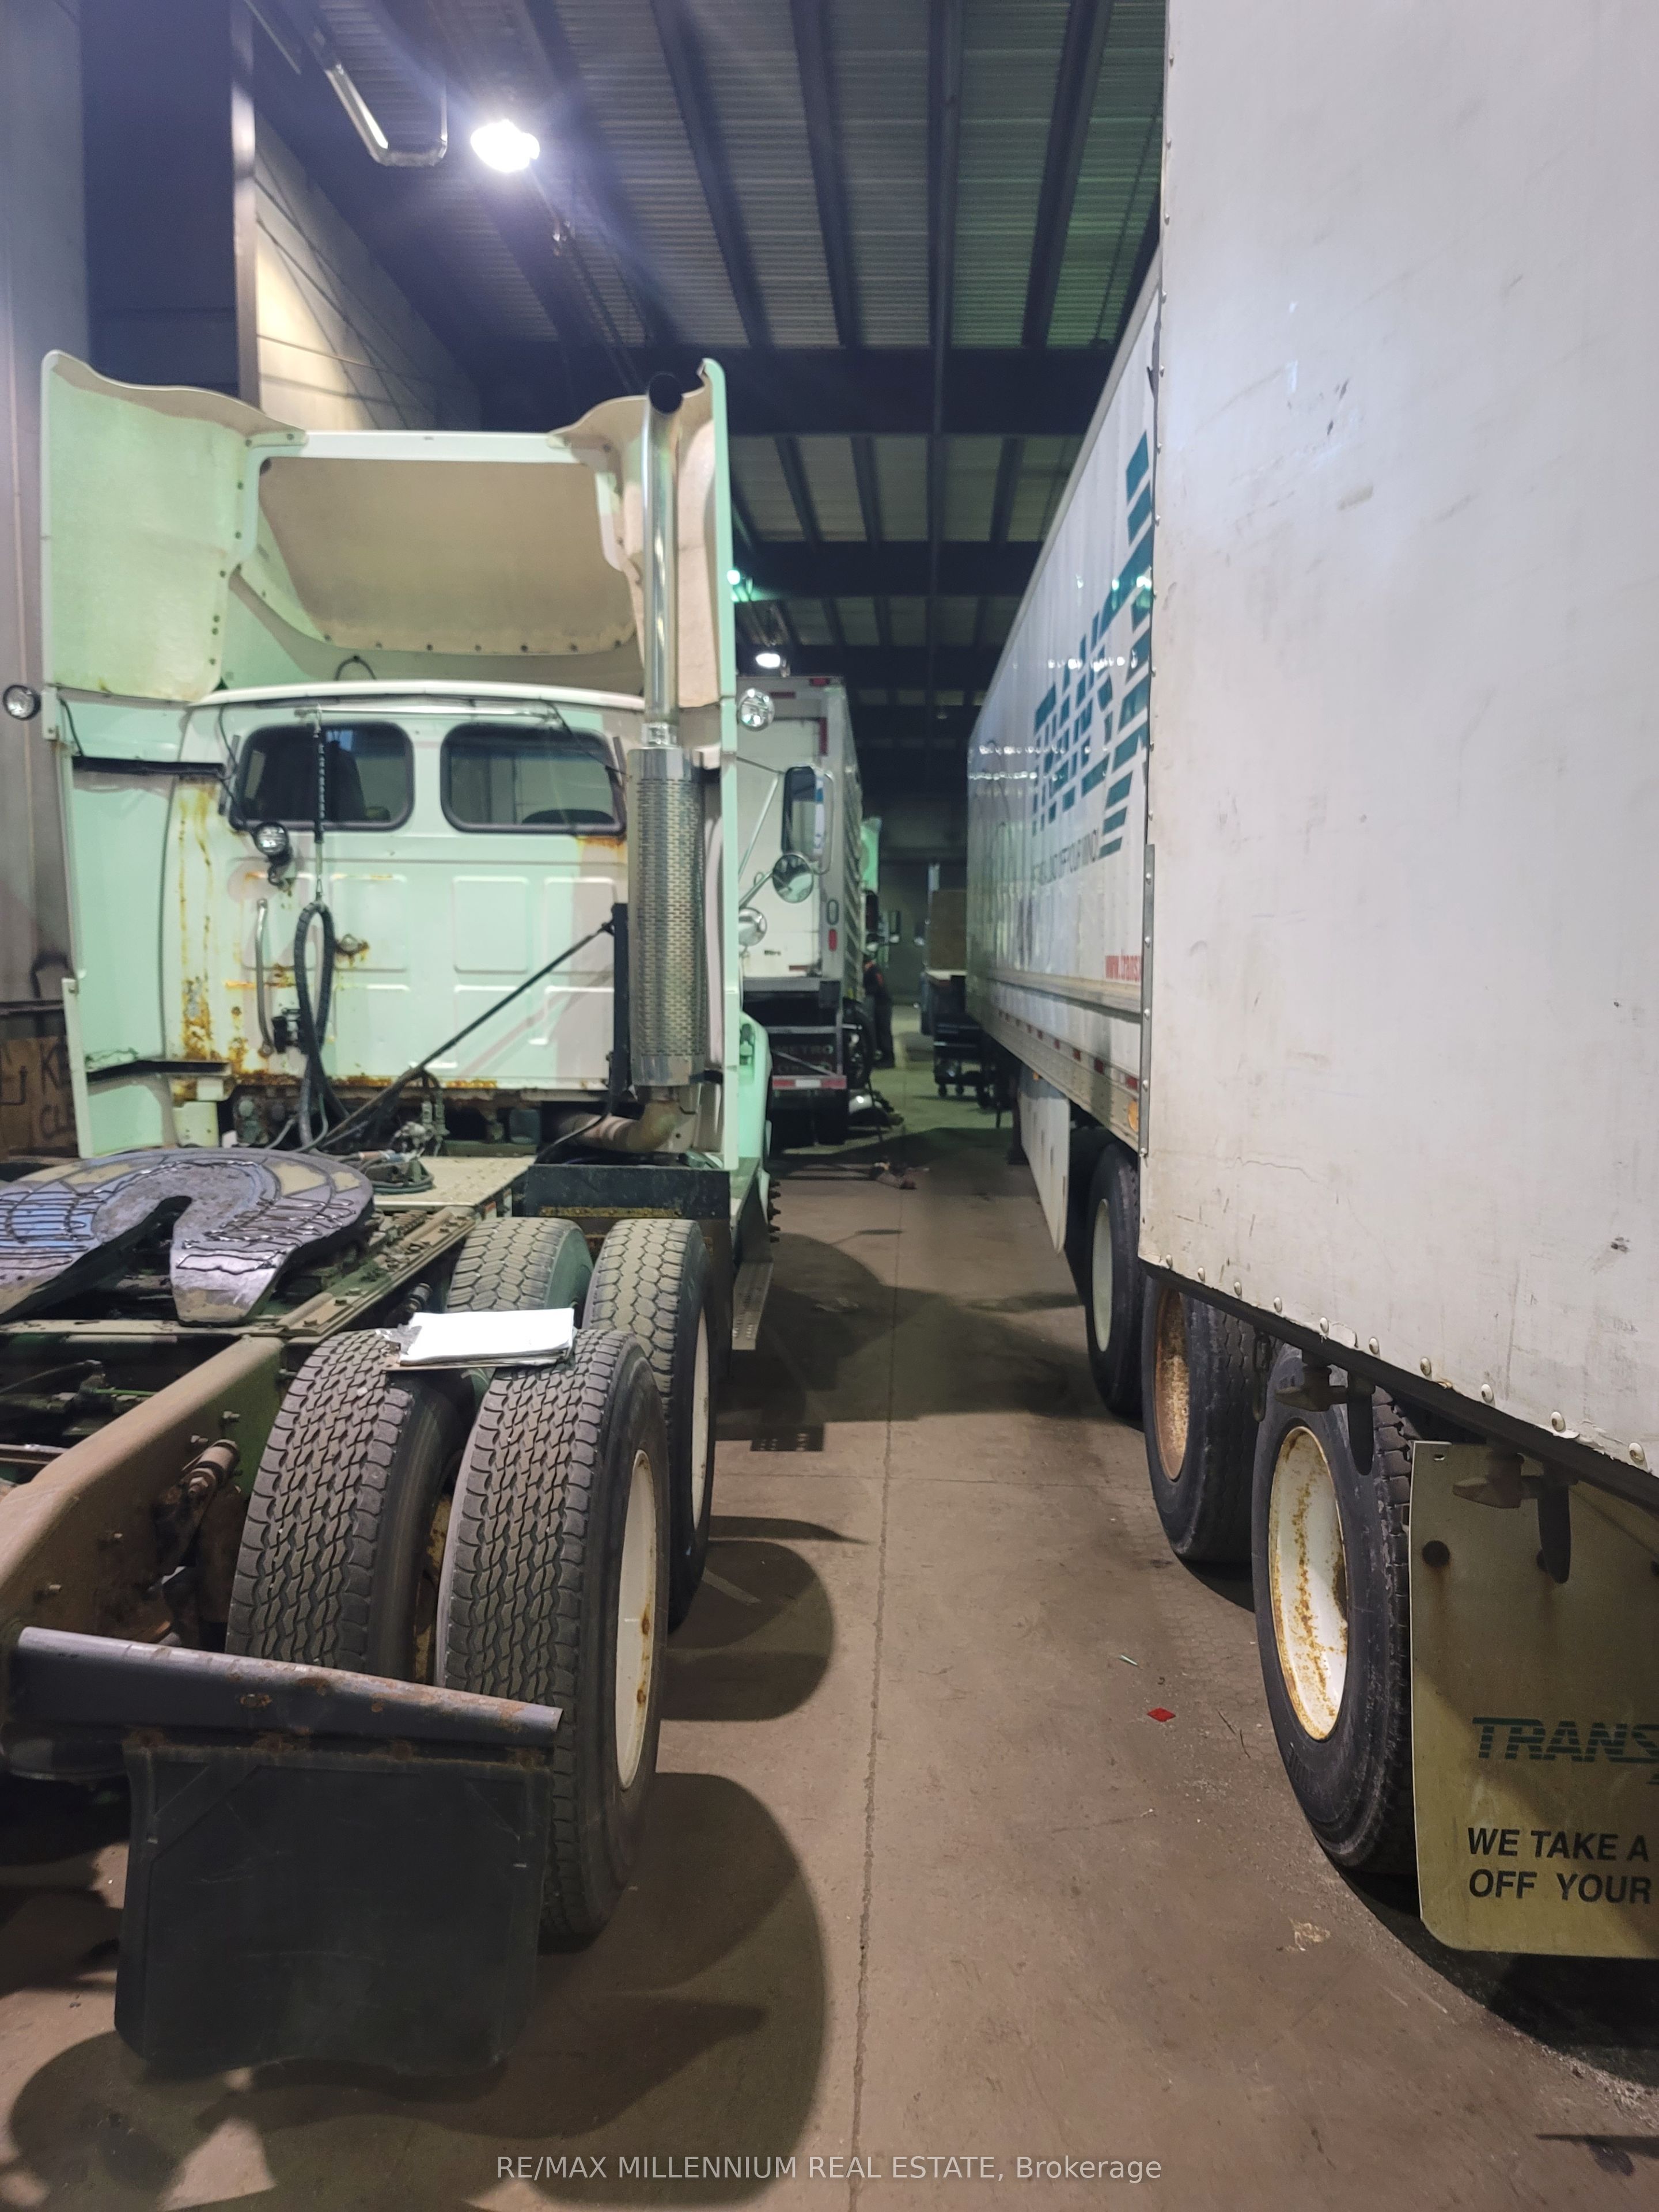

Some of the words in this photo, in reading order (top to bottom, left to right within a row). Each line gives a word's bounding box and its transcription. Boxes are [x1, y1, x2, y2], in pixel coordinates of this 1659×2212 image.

[1467, 1827, 1520, 1857] WE
[1531, 1830, 1619, 1861] TAKE
[1626, 1834, 1650, 1862] A
[1469, 1869, 1538, 1899] OFF
[1556, 1873, 1652, 1905] YOUR
